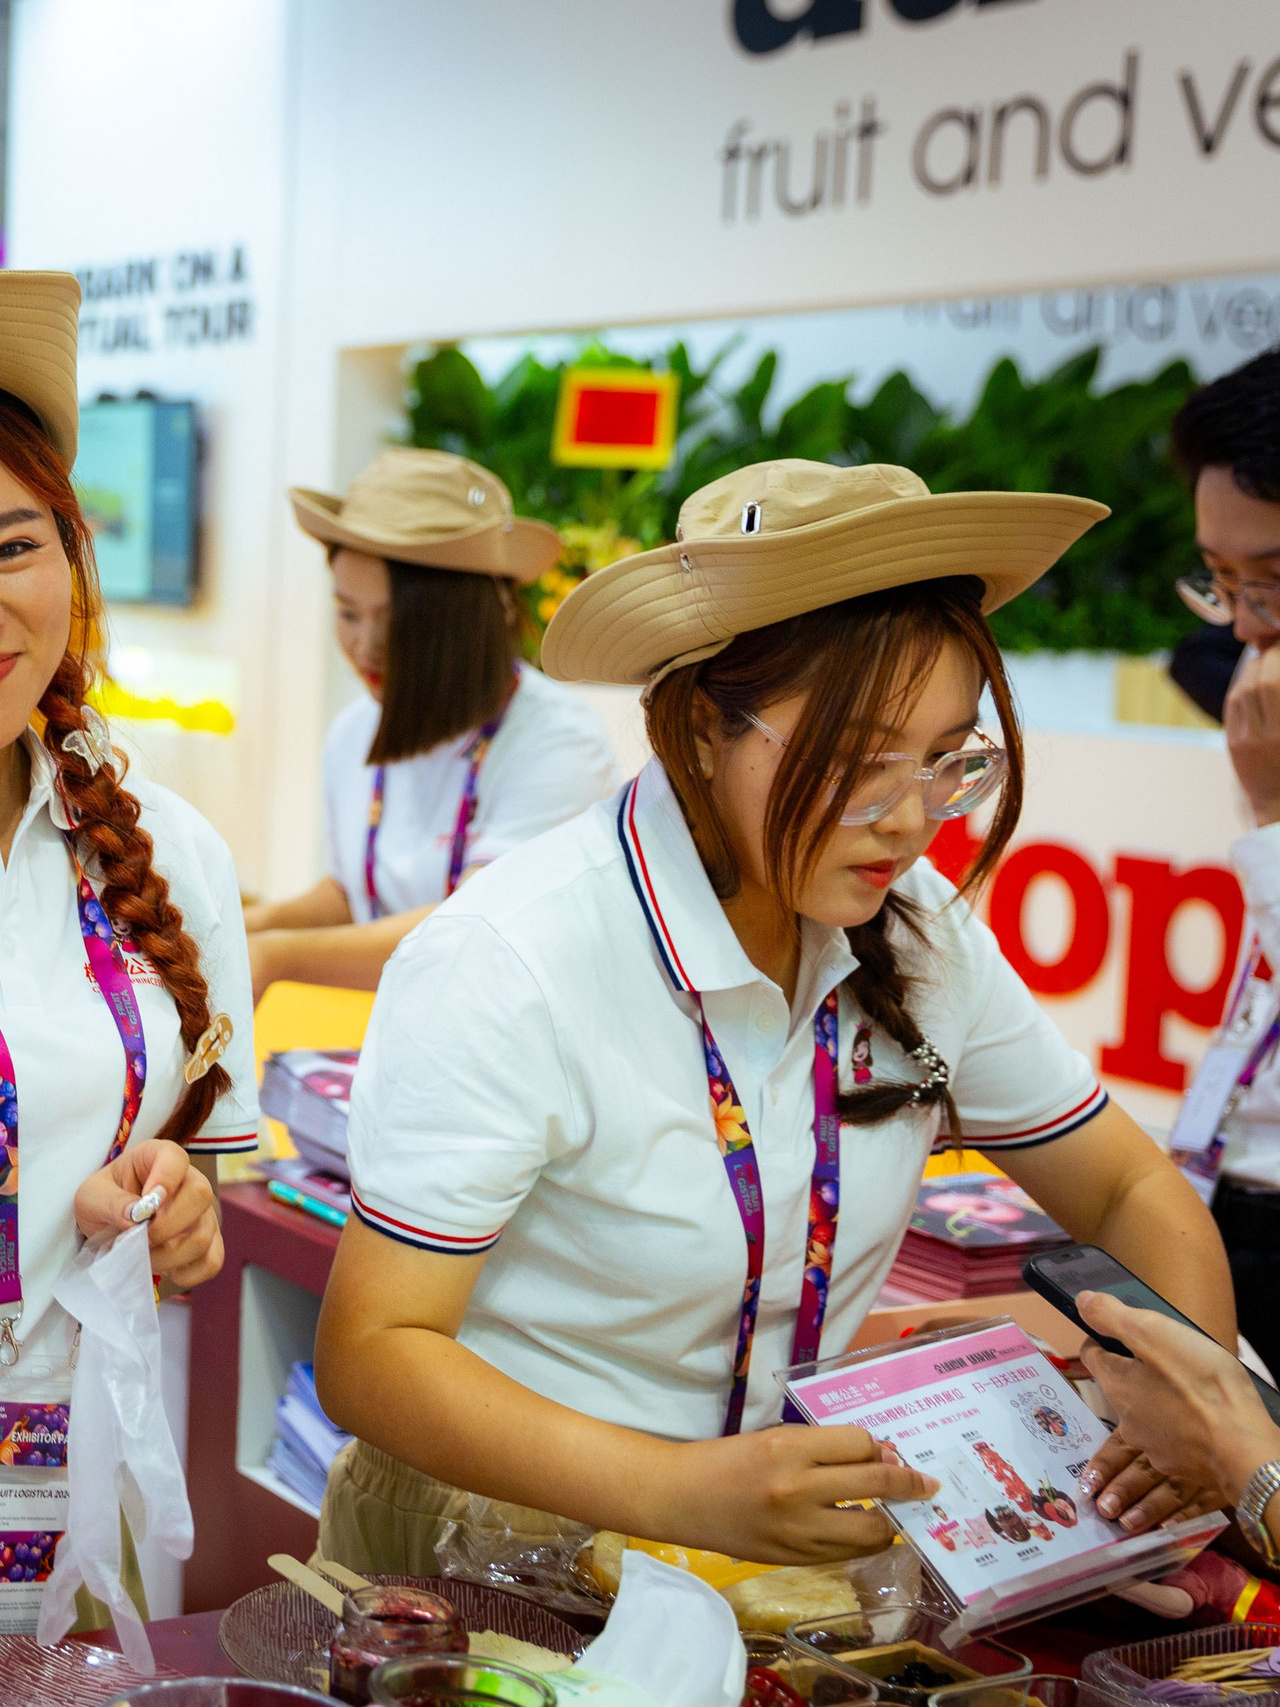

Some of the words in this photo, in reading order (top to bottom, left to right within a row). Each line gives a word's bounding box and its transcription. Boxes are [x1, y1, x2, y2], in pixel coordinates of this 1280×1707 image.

[719, 94, 886, 225] fruit
[912, 44, 1140, 193] and
[11, 1431, 57, 1444] EXHIBITOR
[14, 1489, 53, 1499] LOGISTICA
